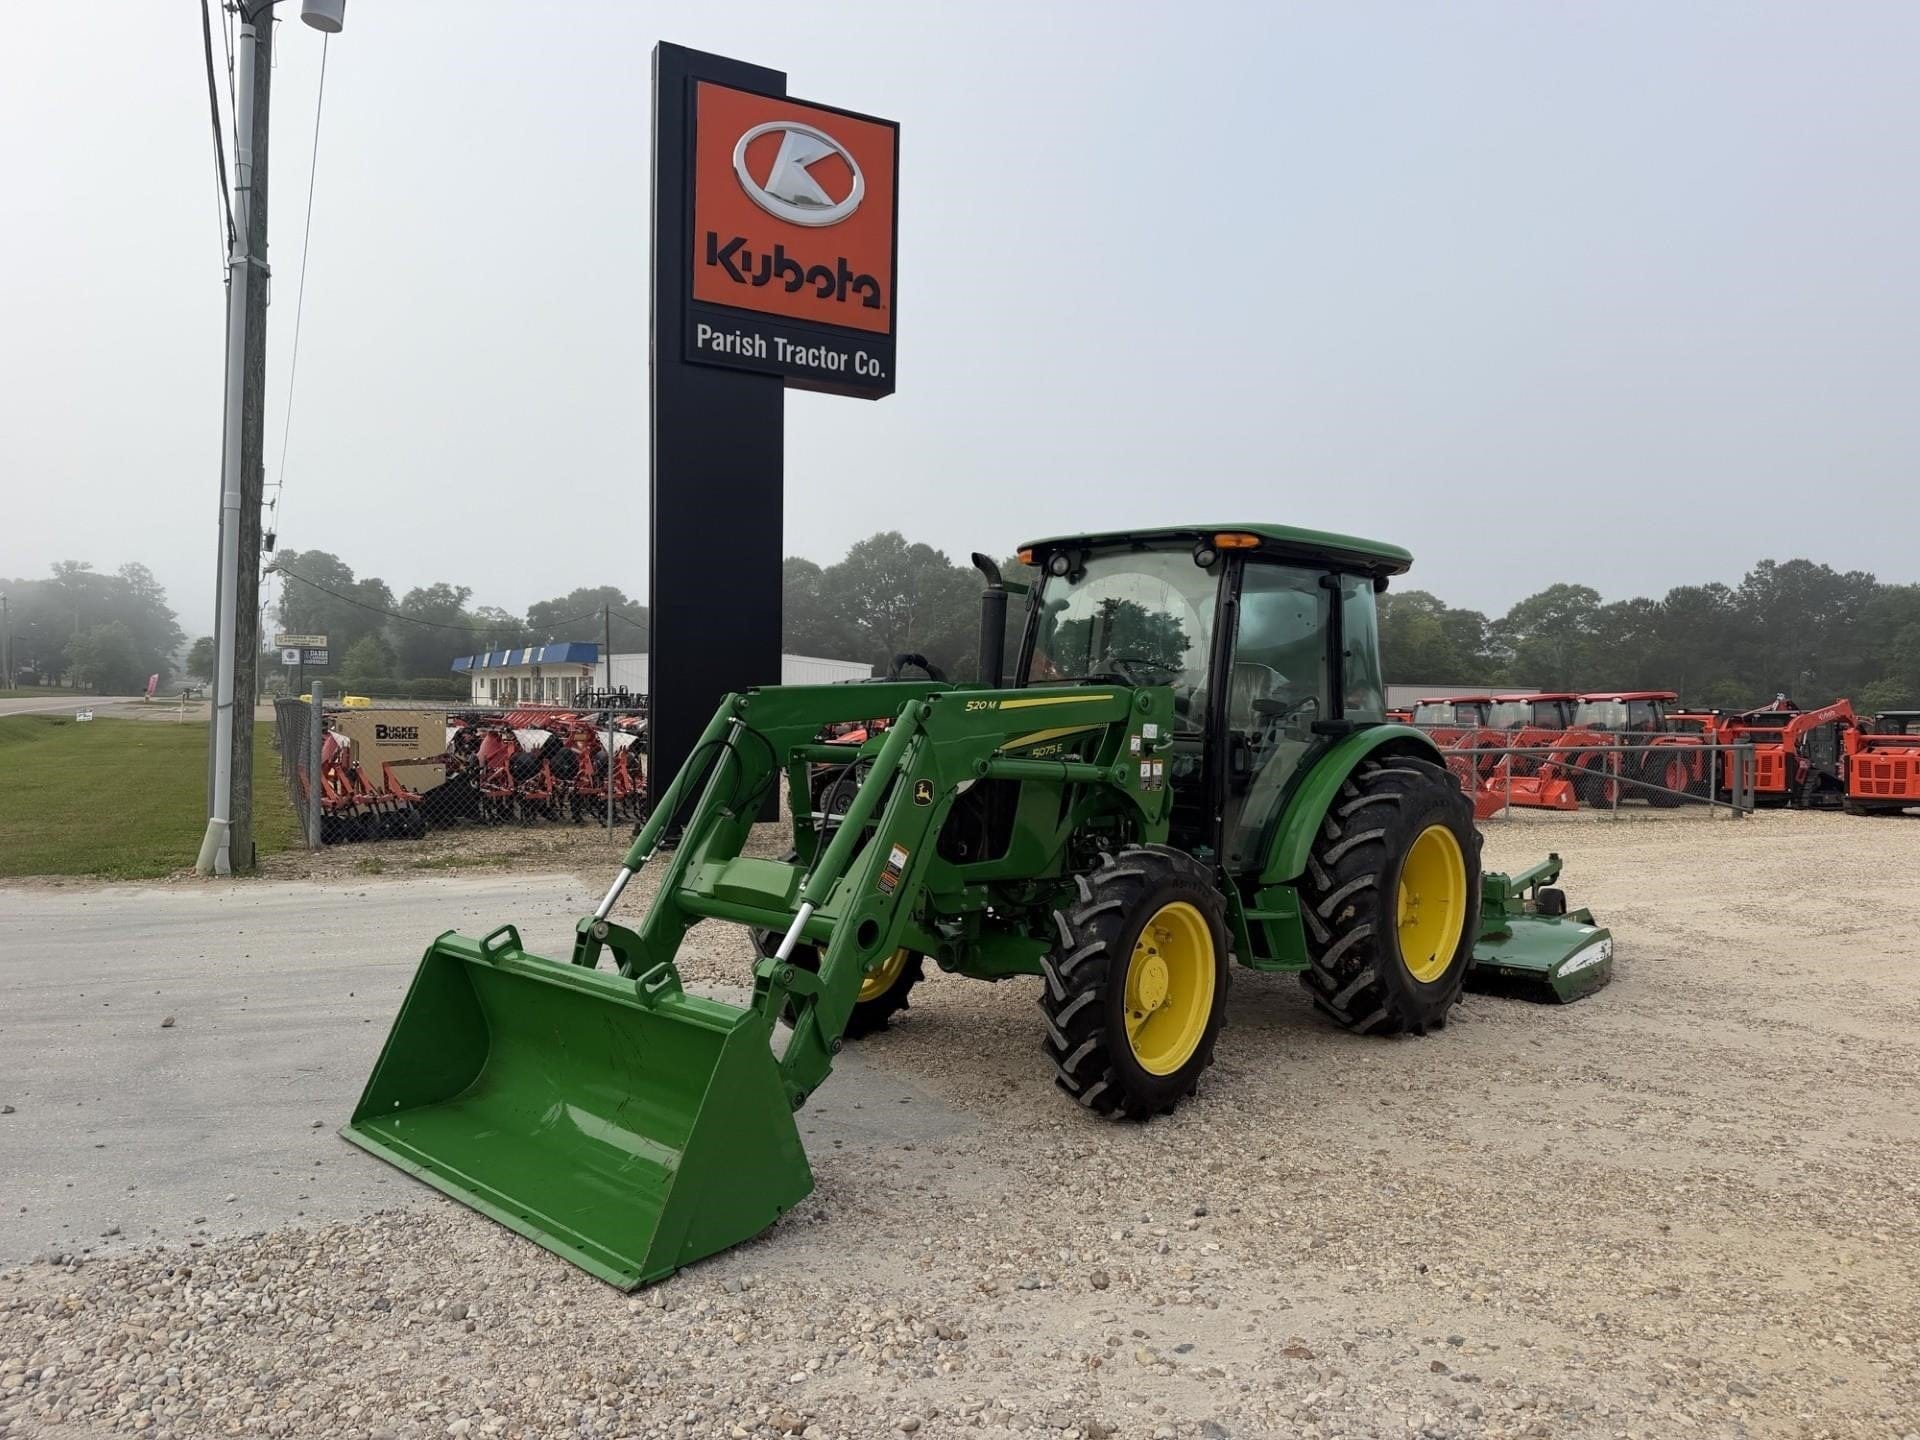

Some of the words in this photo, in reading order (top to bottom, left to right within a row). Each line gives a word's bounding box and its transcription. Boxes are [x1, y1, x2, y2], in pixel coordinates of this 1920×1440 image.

[706, 231, 882, 310] Kubota
[697, 323, 767, 358] Parish
[774, 336, 848, 372] Tractor
[854, 350, 886, 379] Co.
